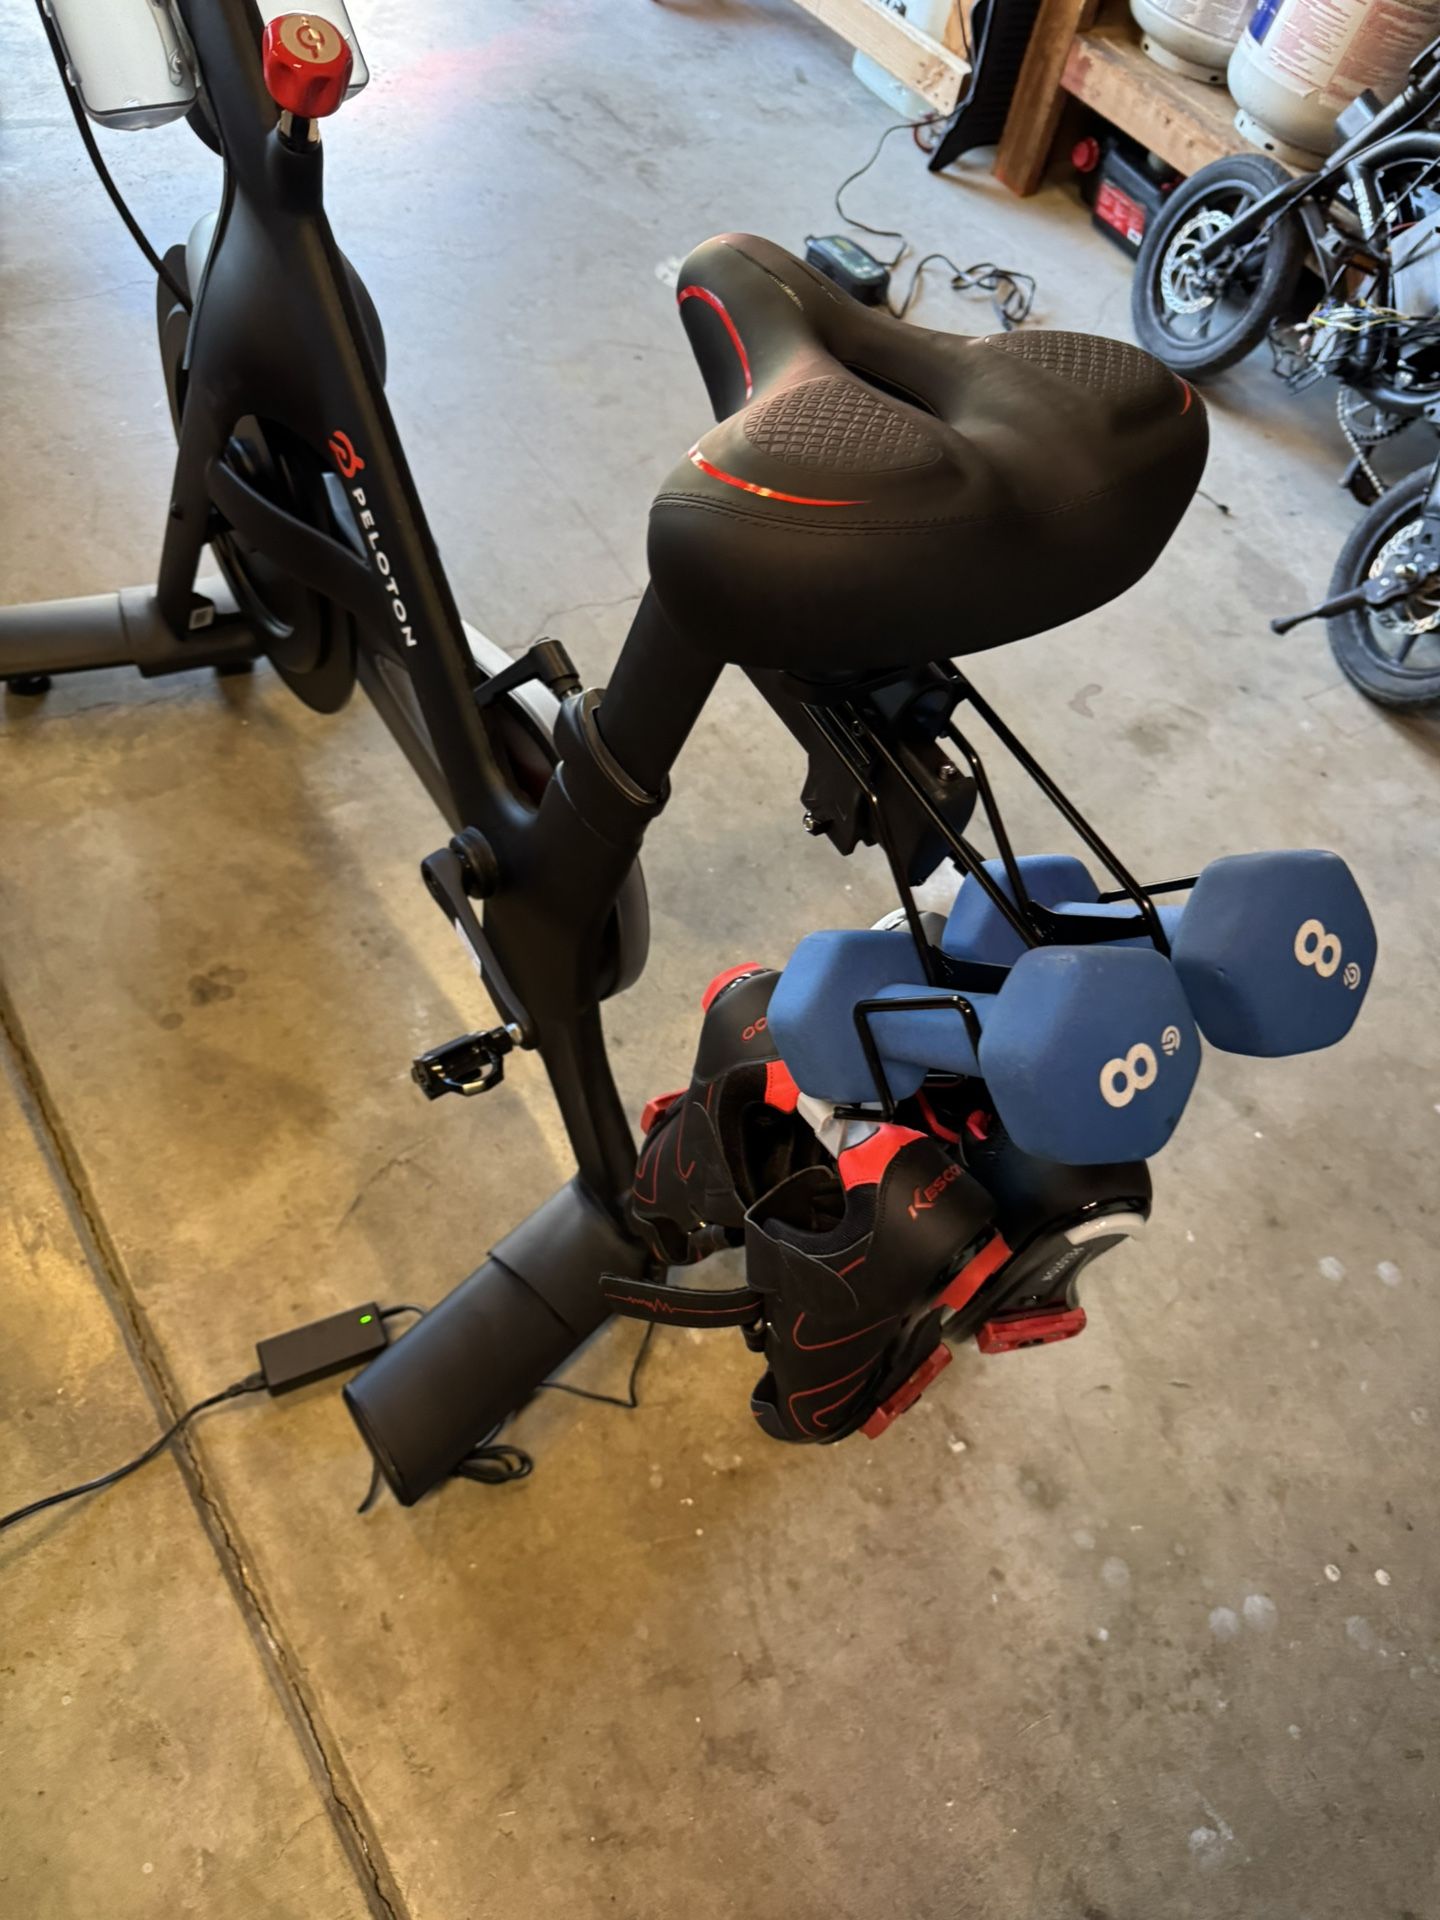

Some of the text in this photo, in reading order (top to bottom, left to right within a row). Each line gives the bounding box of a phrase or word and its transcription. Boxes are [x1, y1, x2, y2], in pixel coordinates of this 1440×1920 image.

[352, 487, 417, 647] PELOTON
[1294, 918, 1342, 978] 8
[1099, 1042, 1158, 1108] 8
